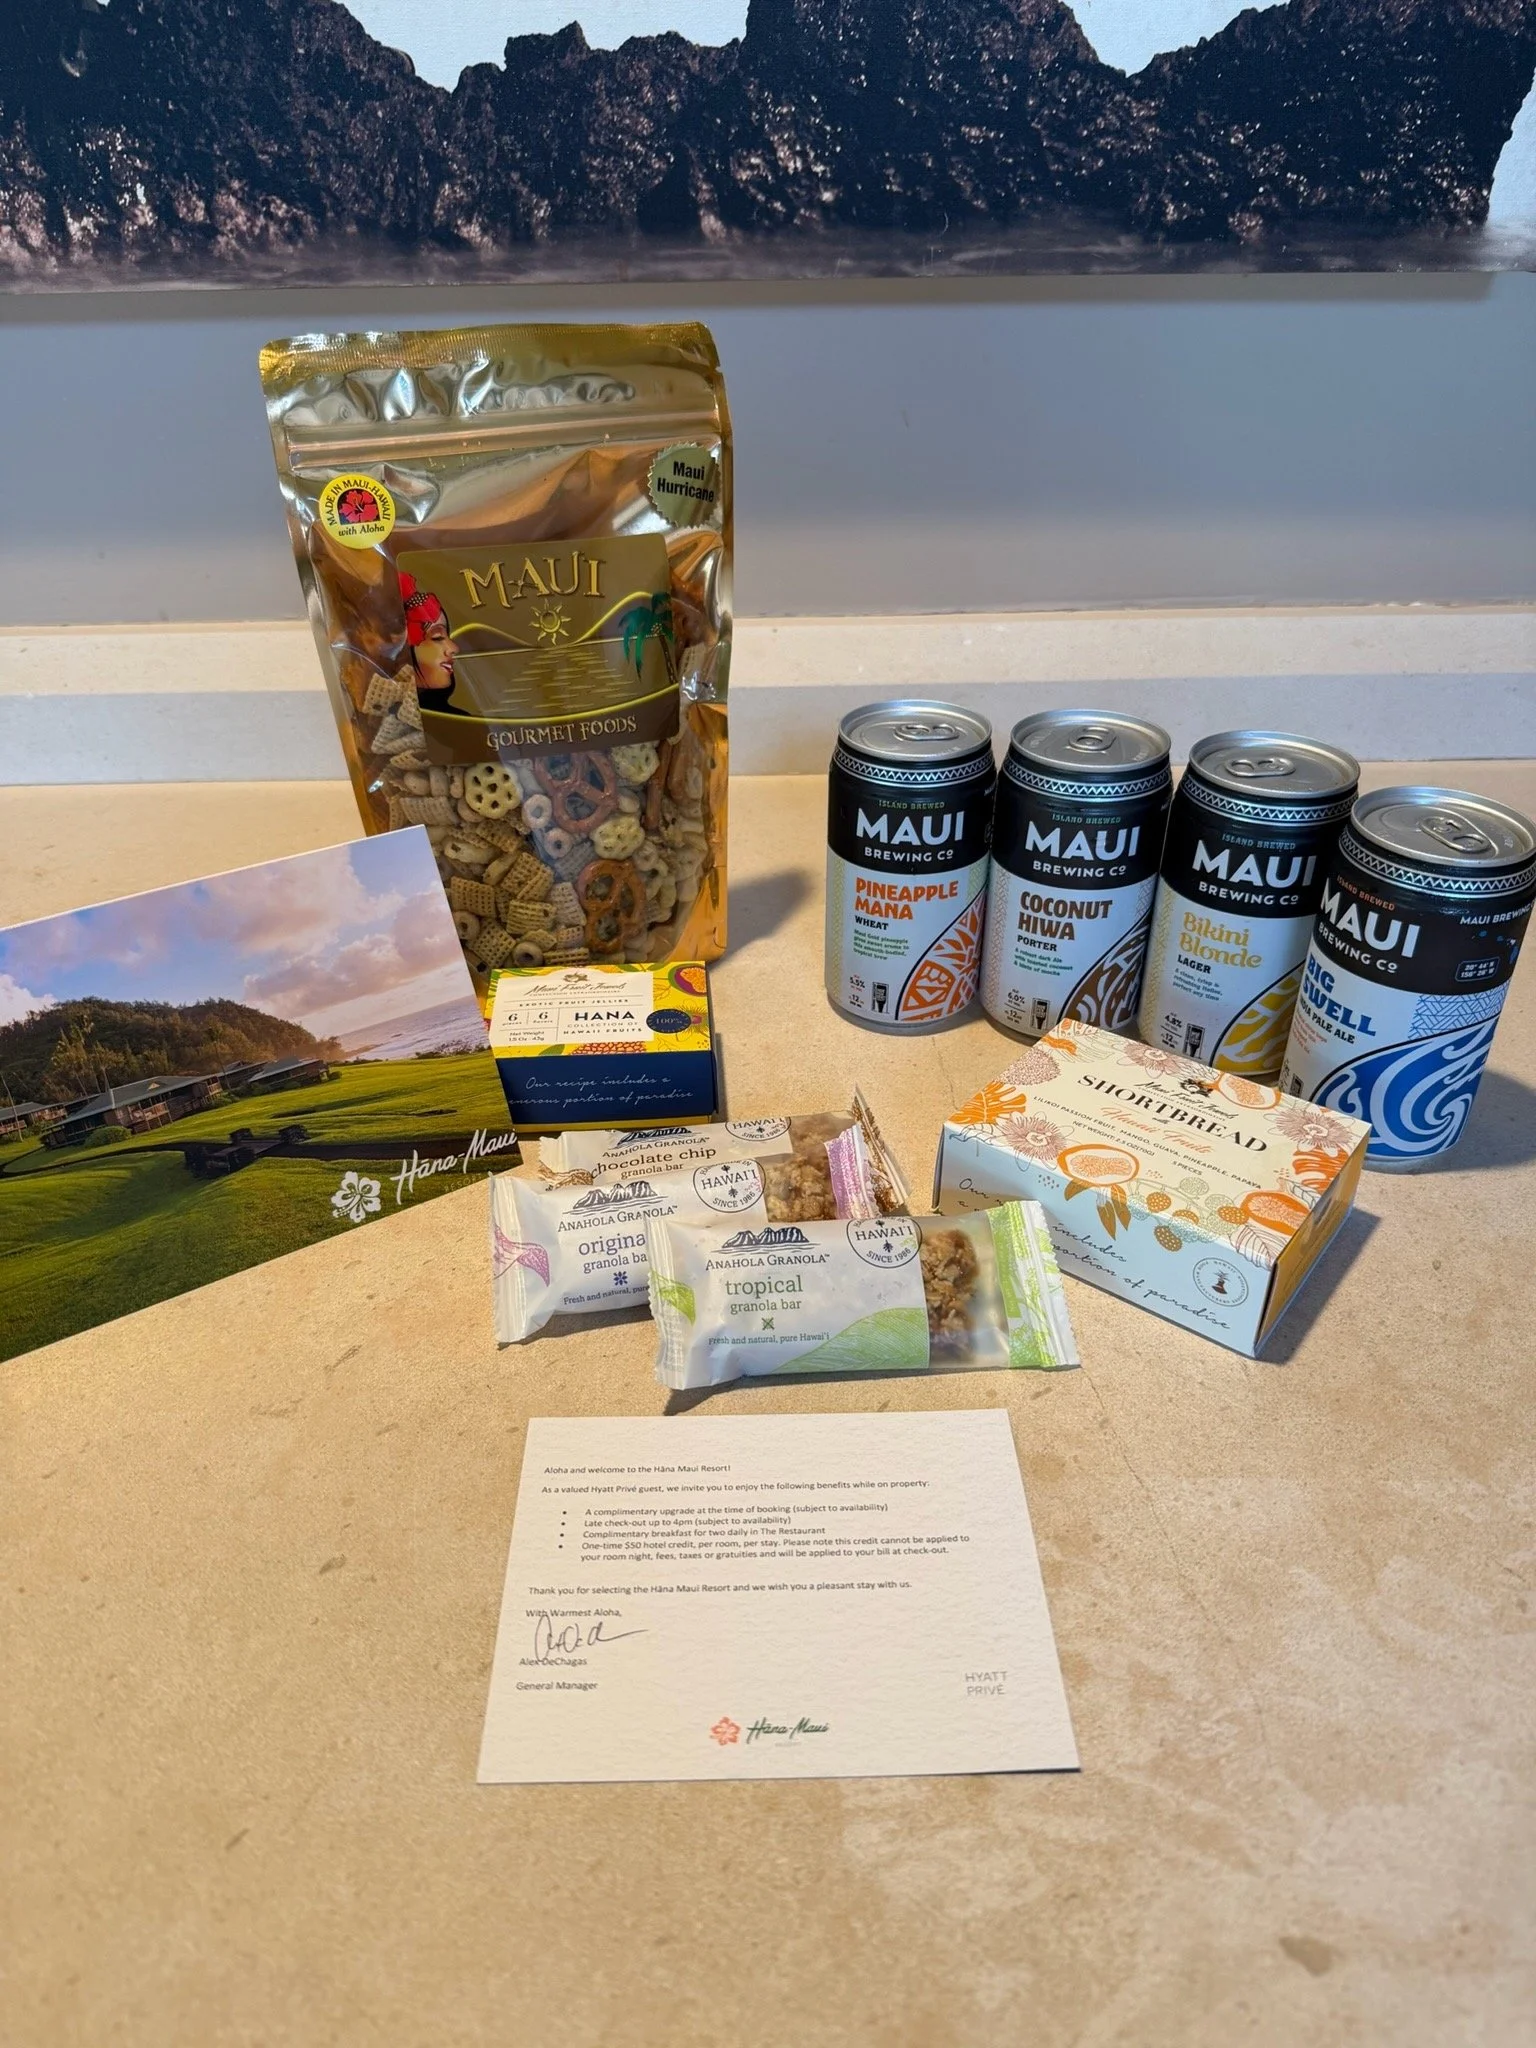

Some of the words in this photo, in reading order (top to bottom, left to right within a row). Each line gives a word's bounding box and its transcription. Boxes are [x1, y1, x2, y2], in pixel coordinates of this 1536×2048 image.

[673, 460, 705, 481] Maui
[657, 477, 714, 503] Hurricane
[325, 496, 337, 526] MADE
[332, 484, 342, 495] IN
[343, 480, 391, 520] MAUI-HAWAII
[339, 528, 357, 536] with
[360, 524, 384, 534] Aloha
[460, 550, 606, 608] MAUI
[487, 724, 574, 750] GOURMET
[580, 716, 637, 740] FOODS
[911, 802, 944, 810] BREWED
[856, 808, 964, 846] MAUI
[1052, 814, 1082, 824] ISLAND
[1025, 820, 1140, 860] MAUI
[1222, 834, 1254, 846] ISLAND
[1257, 840, 1296, 850] BREWED
[864, 846, 932, 862] BREWING
[1192, 840, 1317, 888] MAUI
[1033, 861, 1104, 878] BREWING
[856, 878, 958, 902] PINEAPPLE
[1199, 881, 1274, 905] BREWING
[855, 898, 913, 920] MANA
[1020, 892, 1112, 919] COCONUT
[1359, 890, 1396, 912] BREWED
[855, 916, 888, 930] WHEAT
[1018, 912, 1074, 940] HIWA
[1320, 878, 1420, 958] MAUI
[1460, 916, 1490, 924] MAUI
[1183, 912, 1249, 946] Bikini
[1017, 935, 1057, 952] PORTER
[1180, 932, 1262, 968] Blonde
[1319, 922, 1370, 965] BREWING
[1178, 954, 1211, 974] LAGER
[1308, 952, 1335, 993] BIG
[1303, 974, 1376, 1036] SWELL
[508, 1014, 518, 1022] 6
[539, 1012, 548, 1020] 6
[575, 1011, 634, 1020] HANA
[1312, 1012, 1332, 1033] PALE
[1334, 1027, 1356, 1044] ALE
[526, 1077, 551, 1090] Our
[555, 1078, 596, 1092] recipe
[602, 1074, 657, 1085] includes
[563, 1093, 614, 1108] portion
[619, 1092, 632, 1103] of
[635, 1089, 693, 1104] paradise
[1077, 1074, 1267, 1152] SHORTBREAD
[766, 1128, 780, 1137] 1986
[1073, 1120, 1086, 1128] NET
[1088, 1126, 1115, 1140] WEIGHT:
[1101, 1106, 1162, 1134] Hawaii
[1162, 1129, 1217, 1154] Fruits
[602, 1145, 652, 1158] ANAHOLA
[1034, 1096, 1060, 1108] LILIKOI
[1061, 1106, 1093, 1121] PASSION
[1093, 1118, 1116, 1132] FRUIT,
[1120, 1129, 1151, 1145] MANGO,
[1153, 1143, 1181, 1157] GUAVA,
[1183, 1155, 1228, 1176] PINEAPPLE,
[1231, 1174, 1262, 1189] PAPAYA
[589, 1152, 673, 1180] chocolate
[679, 1145, 716, 1161] chip
[621, 1164, 662, 1179] granola
[665, 1162, 684, 1172] bar
[1177, 1162, 1202, 1176] PIECES
[959, 1178, 989, 1199] Our
[712, 1197, 738, 1208] SINCE
[740, 1192, 756, 1205] 1986
[557, 1216, 615, 1232] ANAHOLA
[578, 1234, 646, 1256] origina
[1053, 1223, 1127, 1263] includes
[584, 1255, 629, 1274] granola
[632, 1253, 648, 1263] ba
[706, 1256, 765, 1270] ANAHOLA
[866, 1250, 892, 1263] SINCE
[895, 1248, 911, 1261] 1986
[564, 1296, 585, 1305] Fresh
[602, 1288, 631, 1297] natural,
[725, 1275, 804, 1299] tropical
[1052, 1245, 1116, 1276] portion
[1123, 1277, 1143, 1290] of
[1147, 1287, 1231, 1330] paradise
[730, 1300, 776, 1315] granola
[780, 1298, 801, 1310] bar
[708, 1336, 729, 1345] Fresh
[731, 1336, 746, 1344] and
[747, 1335, 779, 1344] natural,
[780, 1336, 797, 1346] pure
[570, 1466, 586, 1474] and
[583, 1531, 650, 1540] Complimentary
[727, 1529, 748, 1538] daily
[526, 1609, 548, 1617] With
[594, 1609, 622, 1617] Aloha,
[519, 1658, 537, 1666] Alex
[516, 1682, 553, 1690] General
[556, 1682, 598, 1691] Manager
[965, 1671, 1008, 1683] HYATT
